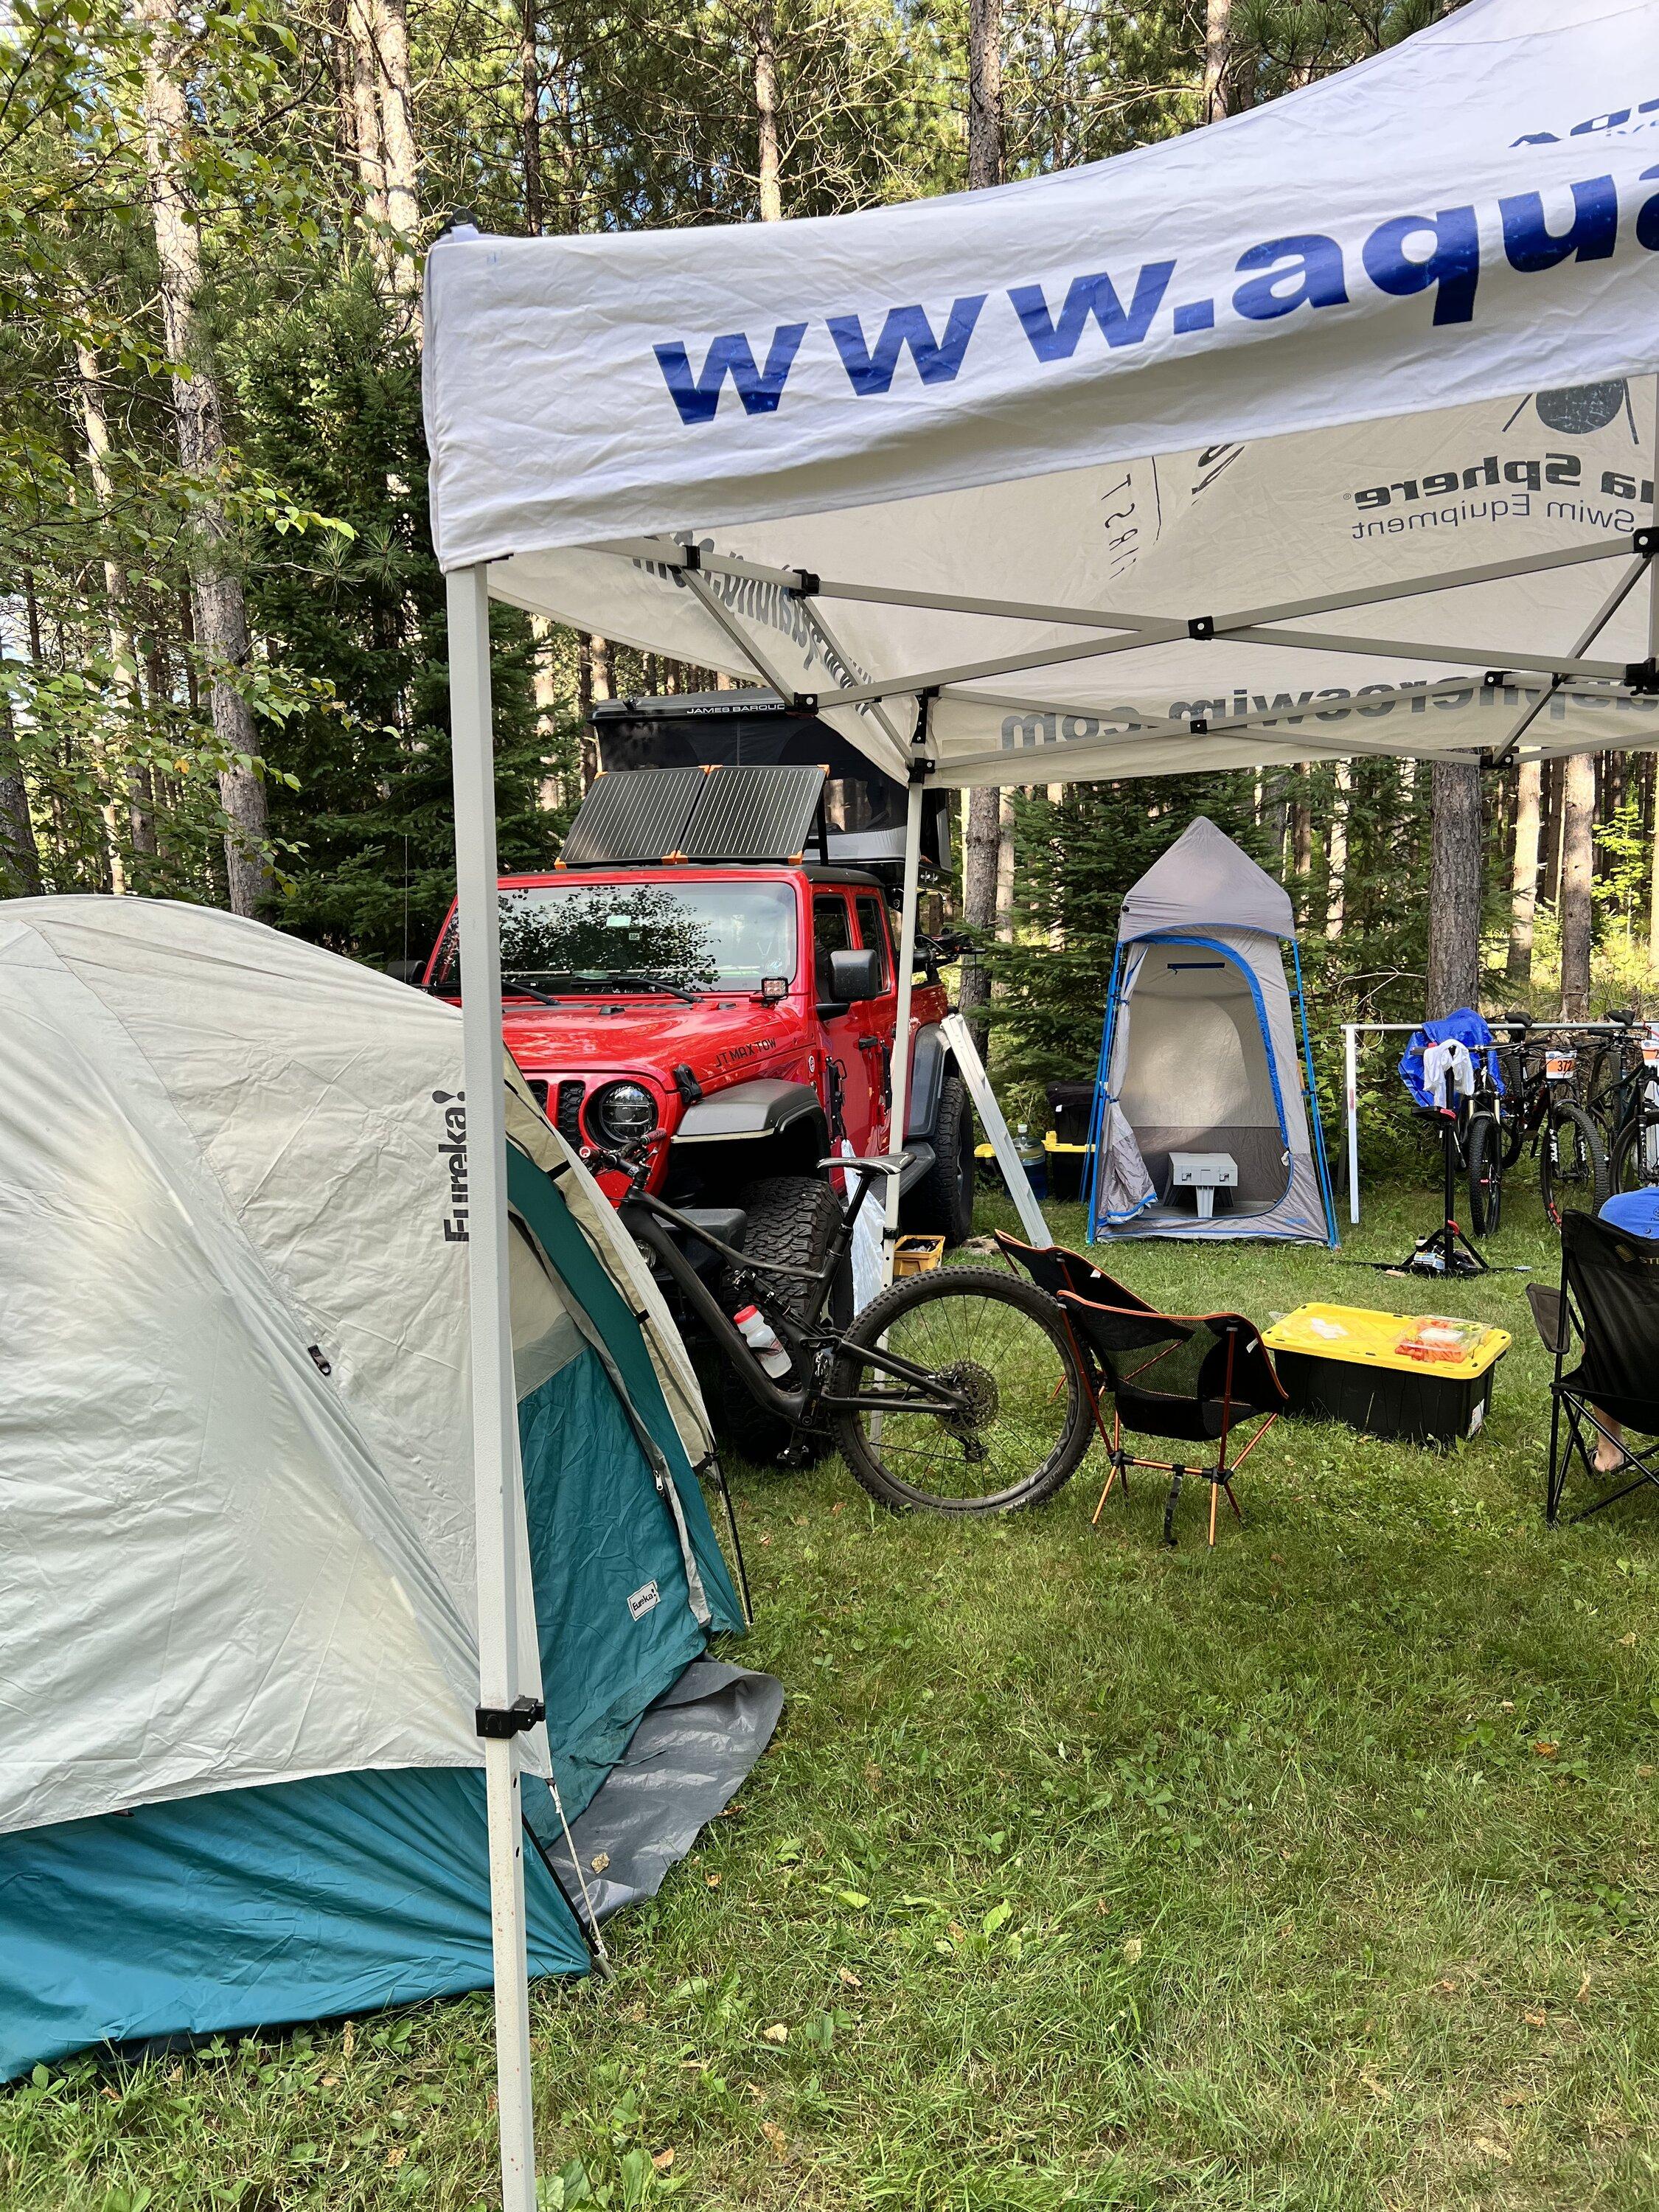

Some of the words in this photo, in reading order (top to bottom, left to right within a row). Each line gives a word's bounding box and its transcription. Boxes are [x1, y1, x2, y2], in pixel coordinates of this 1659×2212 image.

[715, 1052, 730, 1068] JT
[728, 1043, 755, 1062] MAX
[756, 1037, 776, 1053] TOW
[1557, 1060, 1572, 1071] 372
[632, 1588, 656, 1611] Eureka!
